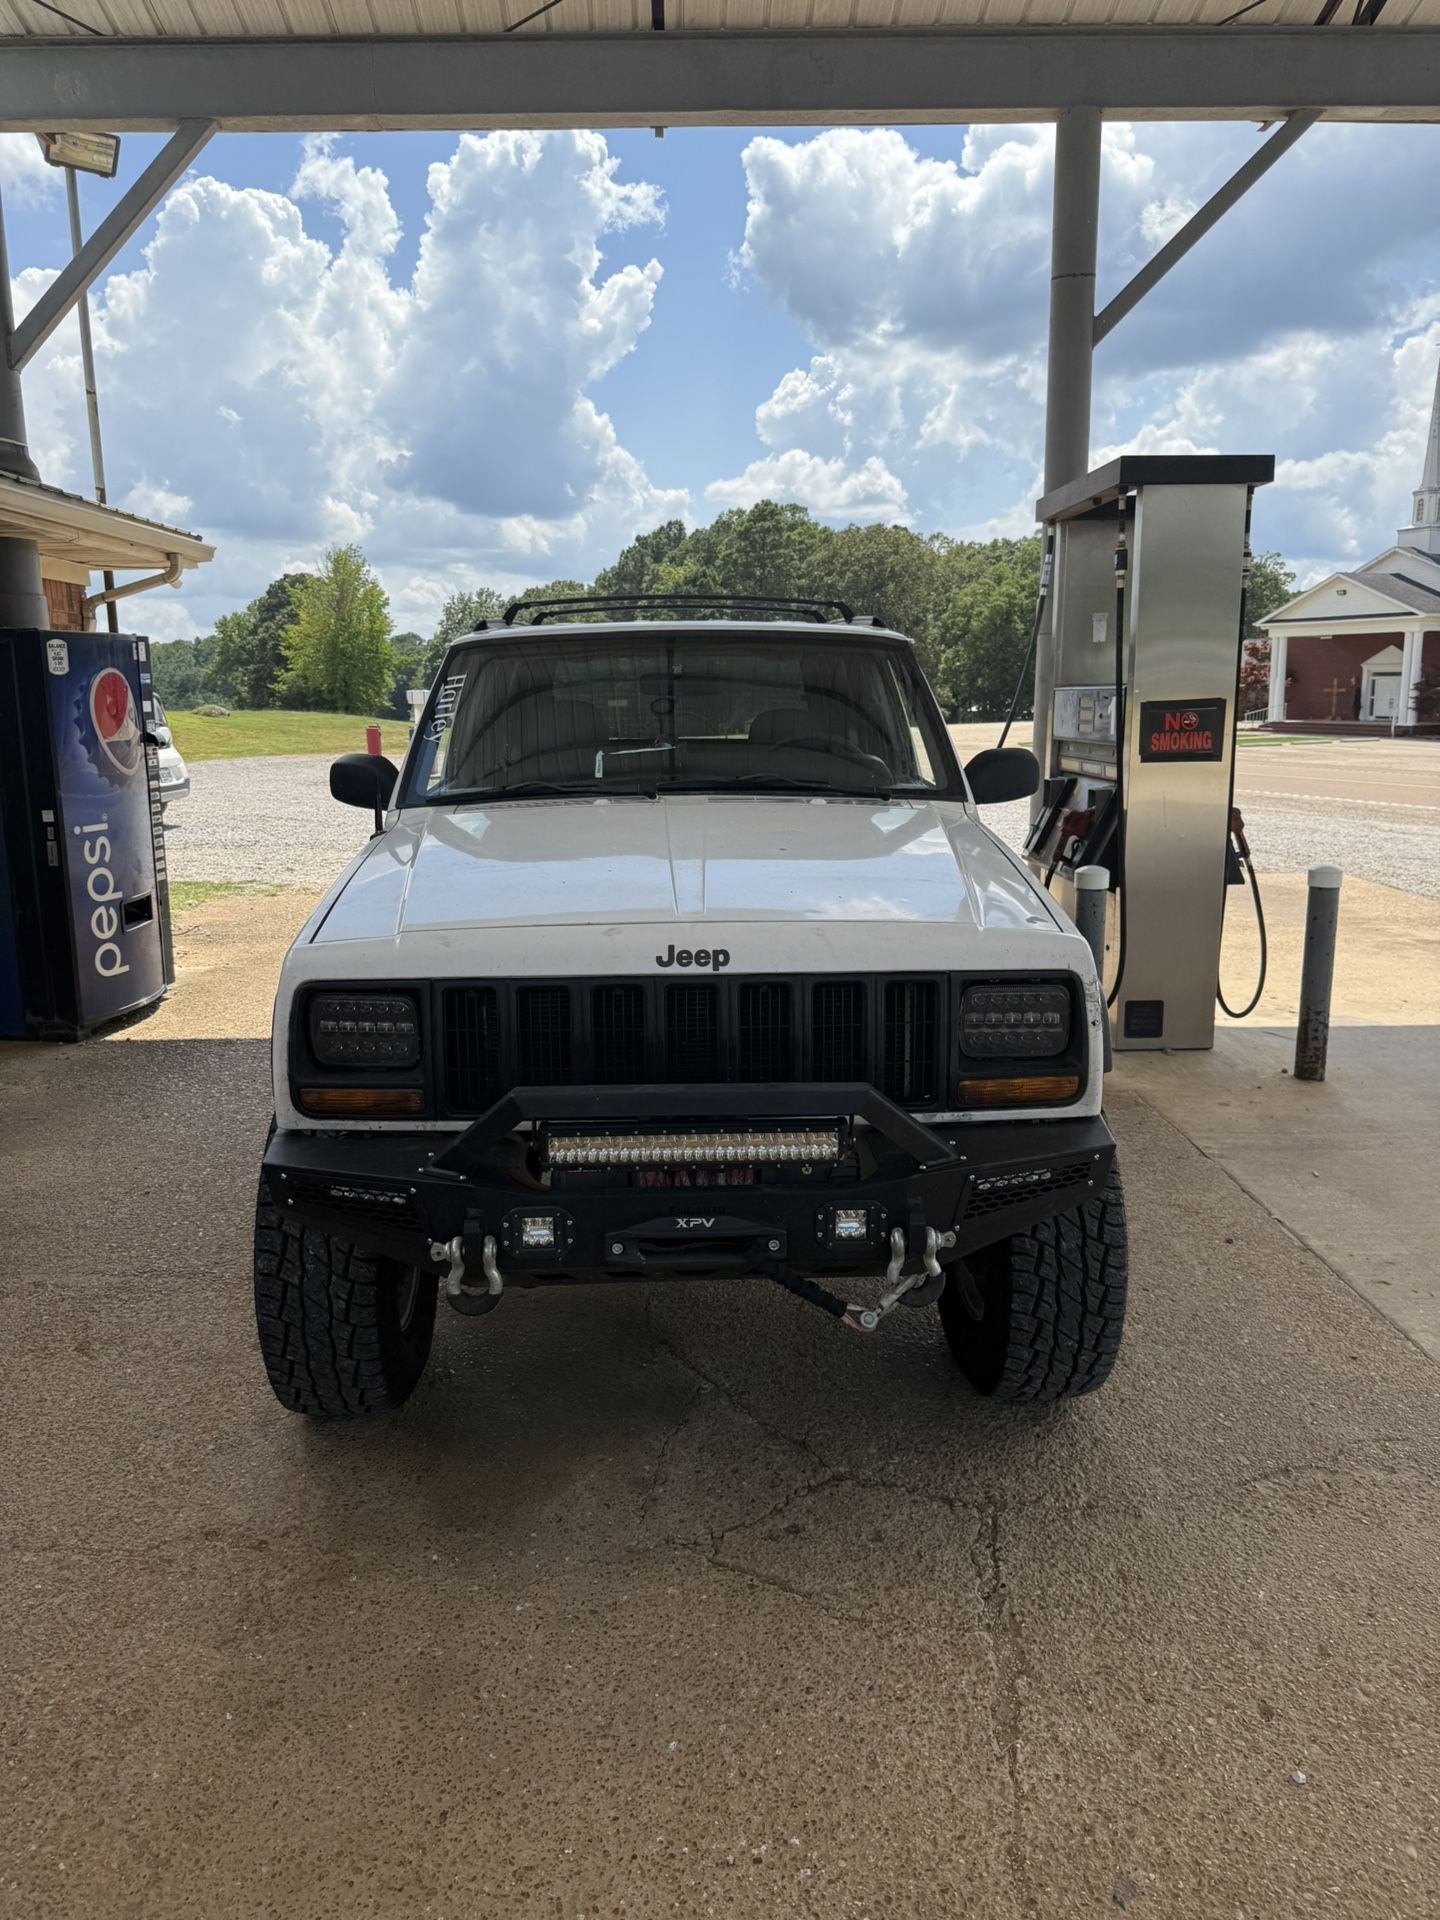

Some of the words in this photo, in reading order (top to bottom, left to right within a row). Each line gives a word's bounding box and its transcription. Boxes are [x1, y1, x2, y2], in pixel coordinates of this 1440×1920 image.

[423, 673, 467, 743] Harley
[1150, 730, 1213, 752] SMOKING
[73, 822, 130, 977] pepsi
[656, 944, 731, 972] Jeep
[674, 1217, 716, 1229] XPV
